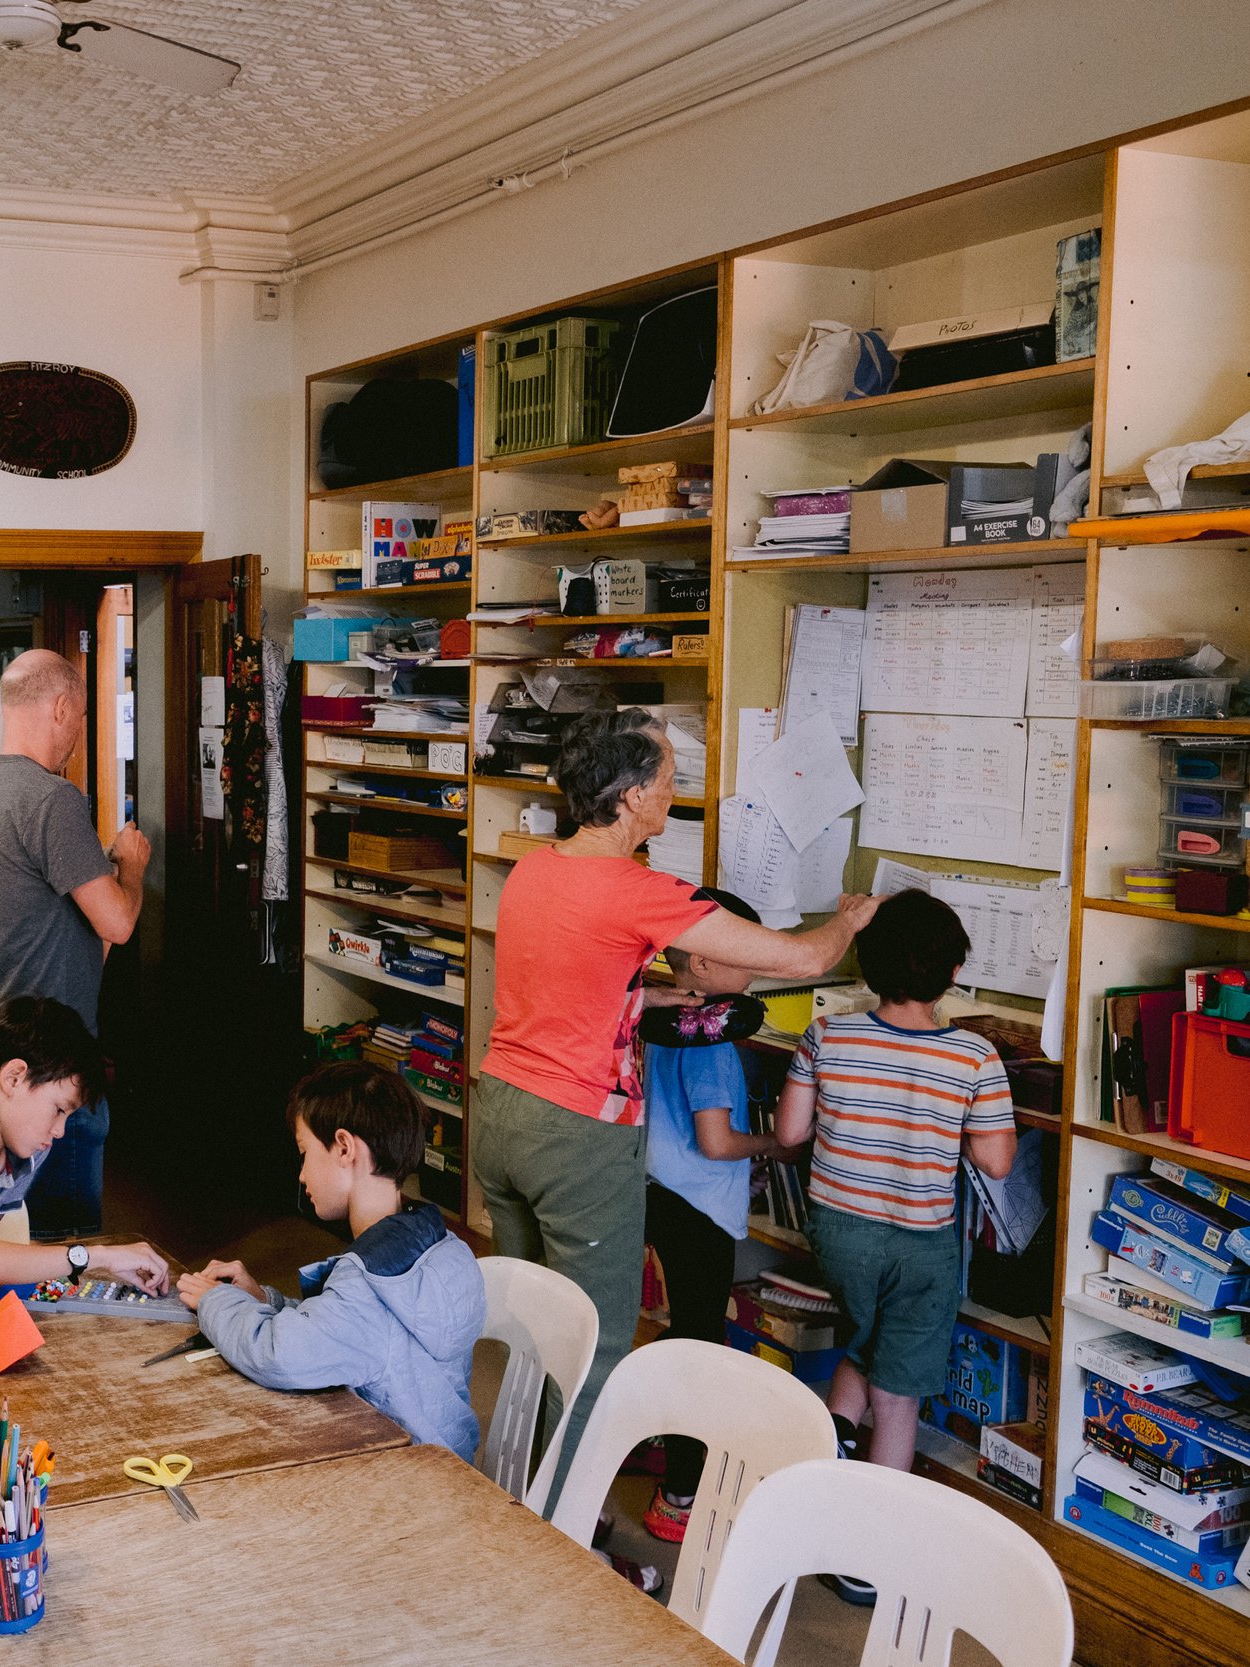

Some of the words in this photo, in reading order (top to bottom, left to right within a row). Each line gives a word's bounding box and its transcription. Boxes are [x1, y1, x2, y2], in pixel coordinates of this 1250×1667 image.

[30, 361, 76, 375] FITZROY
[57, 468, 89, 481] SCHOOL
[374, 518, 438, 538] HOW
[974, 524, 983, 532] A4
[984, 520, 1018, 531] EXERCISE
[985, 529, 1007, 539] BOOK
[309, 554, 343, 567] Twister
[414, 562, 430, 570] SUPER
[415, 569, 441, 580] SCRABBLE
[611, 564, 632, 574] White
[611, 575, 636, 585] board
[913, 574, 957, 588] Monday
[611, 586, 644, 597] markers
[670, 586, 710, 599] Certificat
[345, 938, 370, 954] Qwirkle
[427, 1018, 459, 1040] MONOPOLY
[946, 1366, 973, 1393] rld
[1169, 1368, 1189, 1381] BEAR
[953, 1389, 991, 1423] map
[1123, 1390, 1199, 1430] Rummikub
[1207, 1432, 1223, 1442] That's
[1208, 1426, 1219, 1434] The
[1220, 1431, 1237, 1442] Family
[1219, 1505, 1241, 1523] 100
